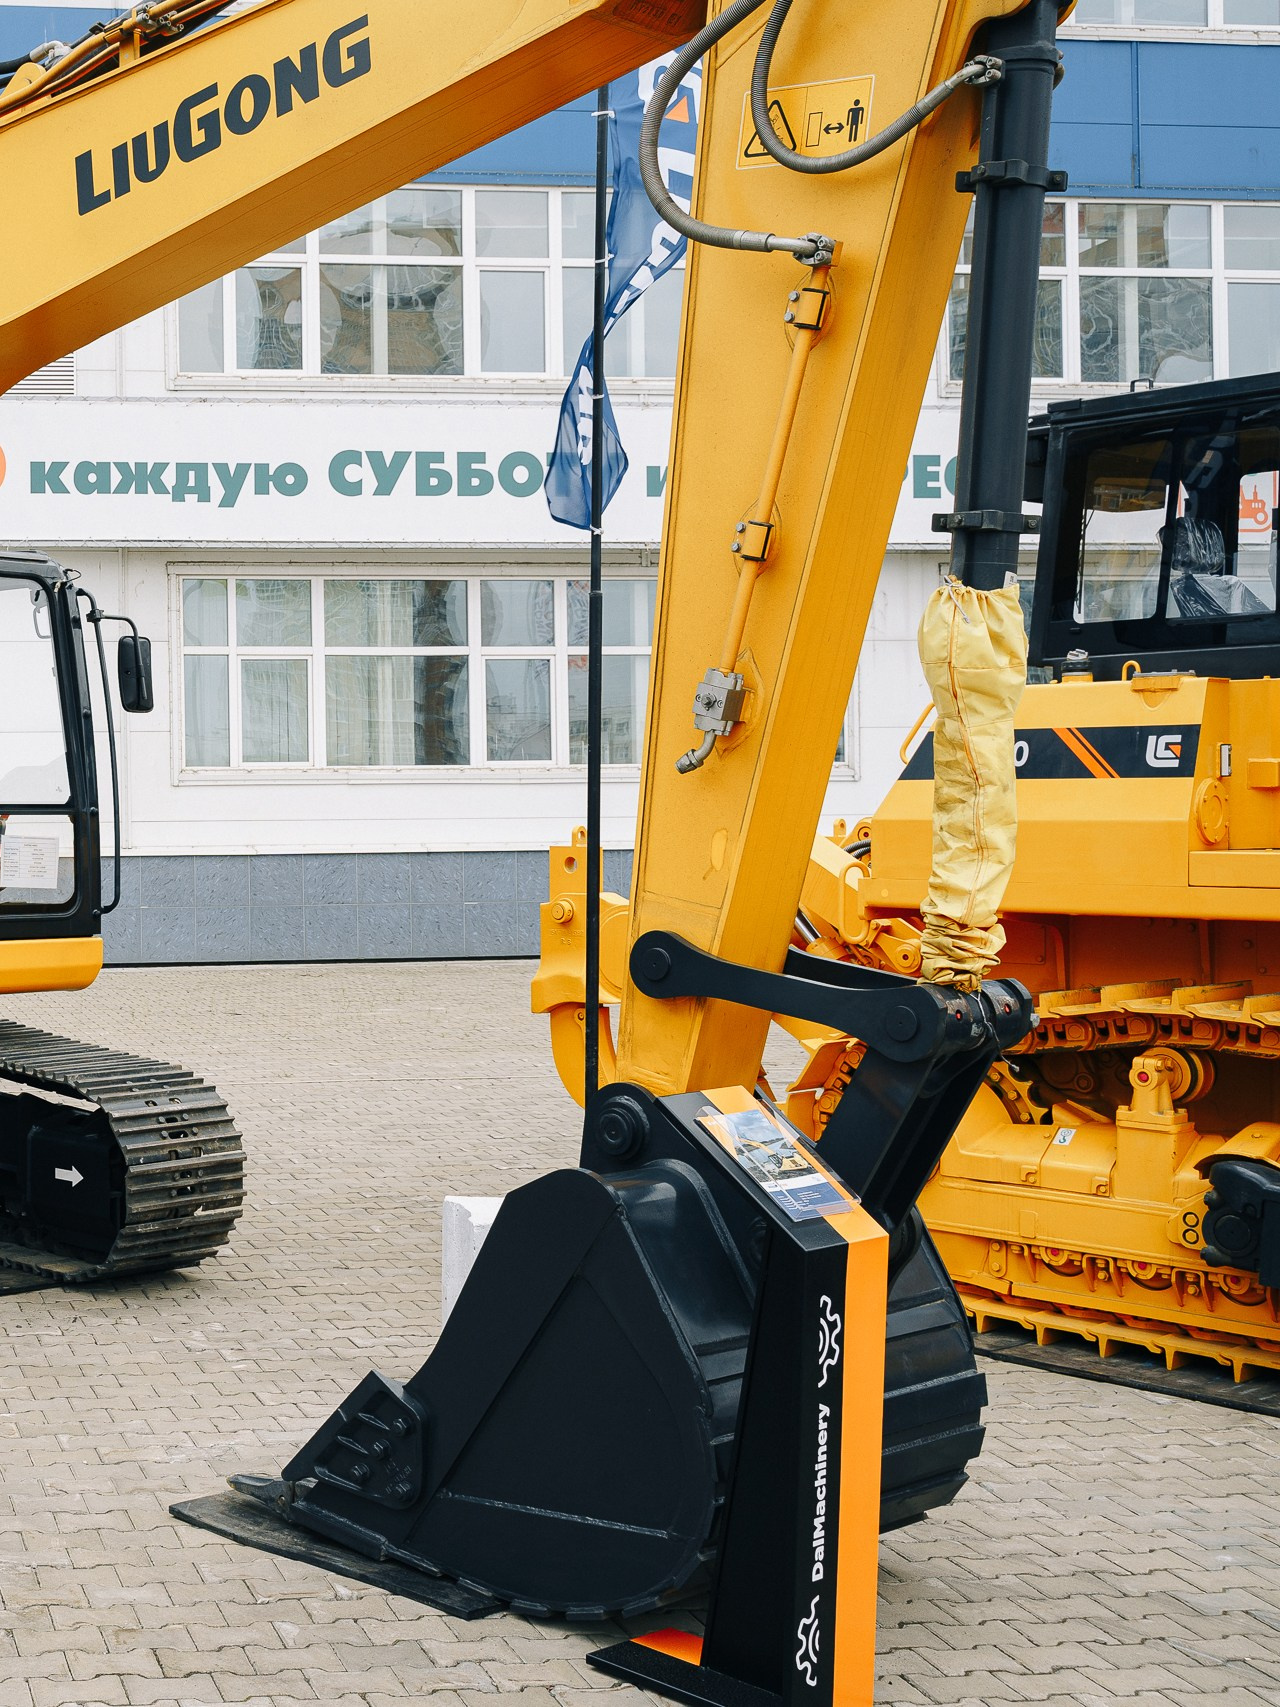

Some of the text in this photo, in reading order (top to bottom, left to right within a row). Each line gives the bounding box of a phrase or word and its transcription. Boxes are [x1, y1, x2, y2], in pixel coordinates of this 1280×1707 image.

[75, 13, 372, 216] LIUGONG
[30, 461, 309, 508] каждую
[328, 450, 626, 497] СУББОТ
[812, 1404, 830, 1582] DalMachinery
